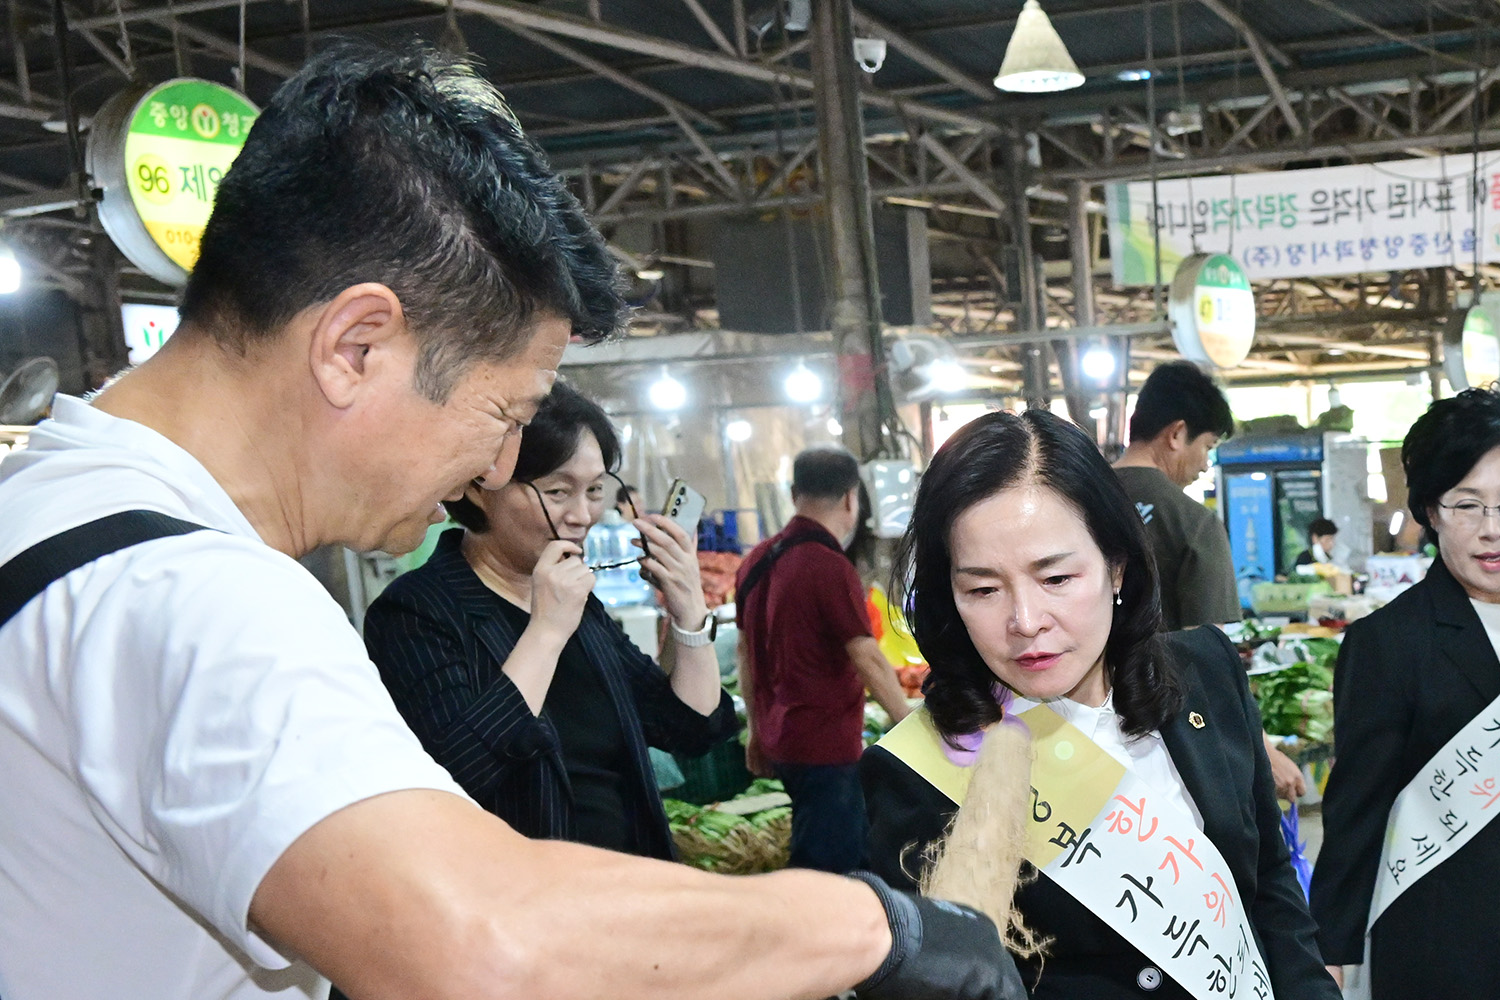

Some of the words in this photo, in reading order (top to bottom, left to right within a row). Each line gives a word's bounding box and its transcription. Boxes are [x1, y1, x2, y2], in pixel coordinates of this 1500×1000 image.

[149, 101, 190, 131] 중앙
[138, 164, 170, 194] 96
[1104, 792, 1235, 928] 한가위
[1387, 808, 1469, 886] 되세요
[1115, 872, 1237, 1000] 가득한
